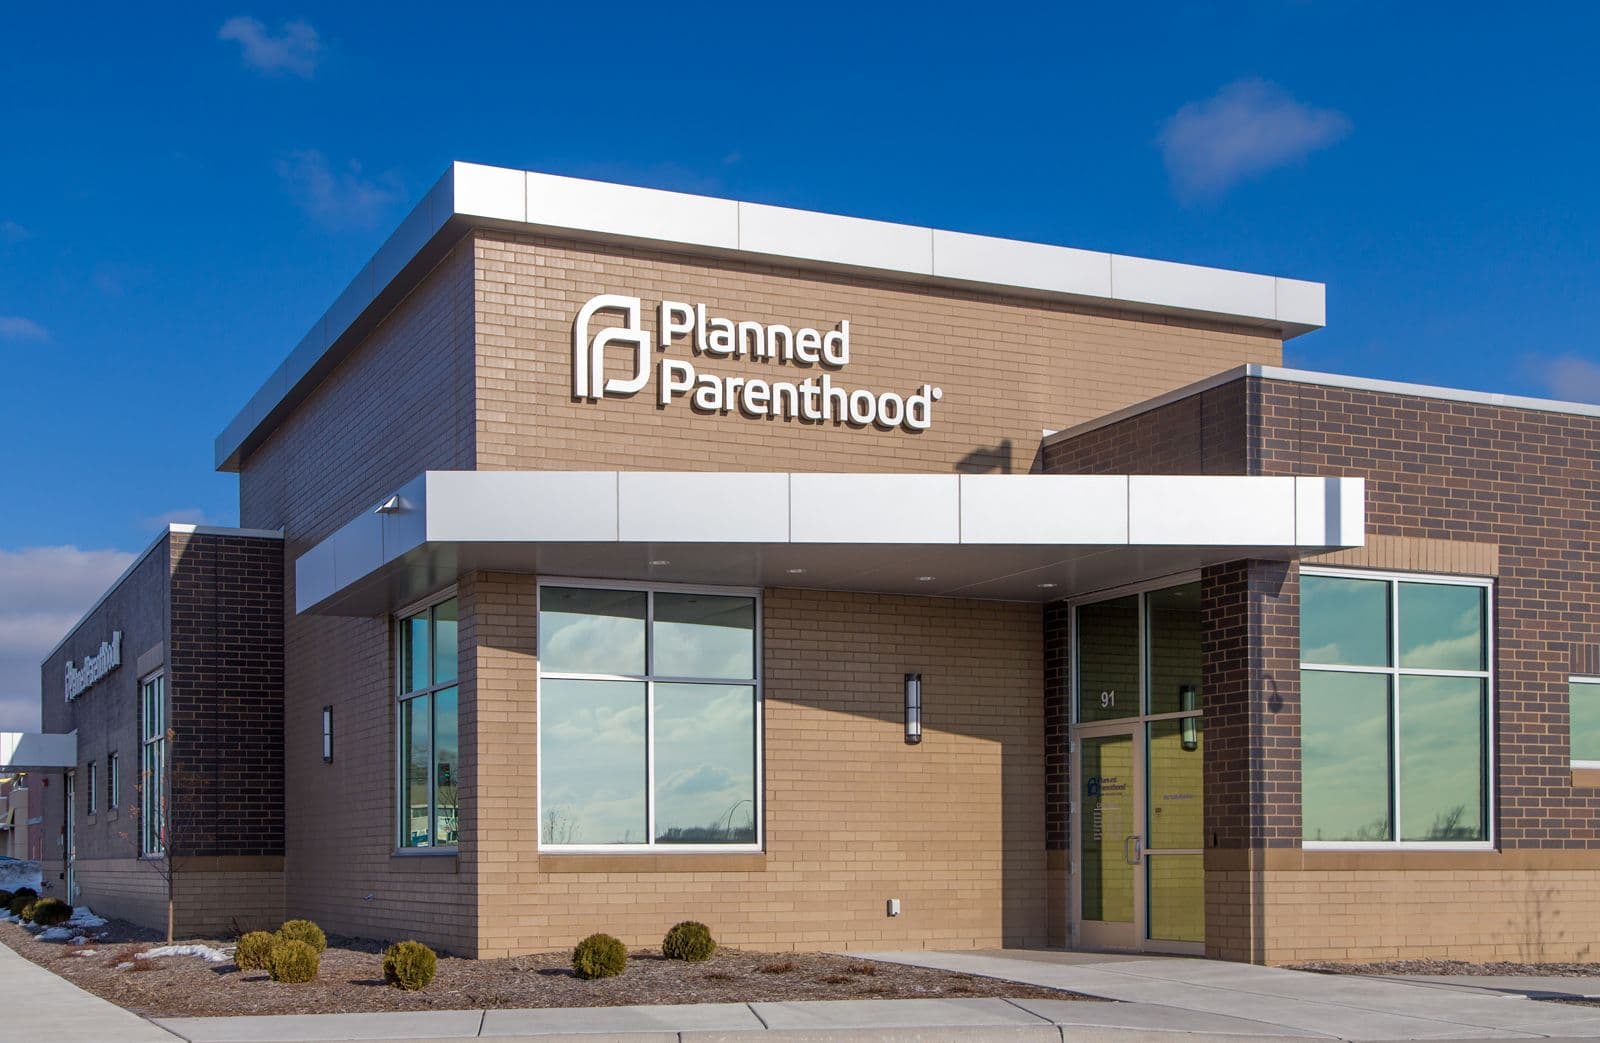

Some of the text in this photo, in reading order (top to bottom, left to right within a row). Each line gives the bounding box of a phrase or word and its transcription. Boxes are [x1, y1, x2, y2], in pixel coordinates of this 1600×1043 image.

[660, 300, 850, 366] Planned
[660, 357, 932, 429] Parenthood
[1101, 690, 1115, 708] 91
